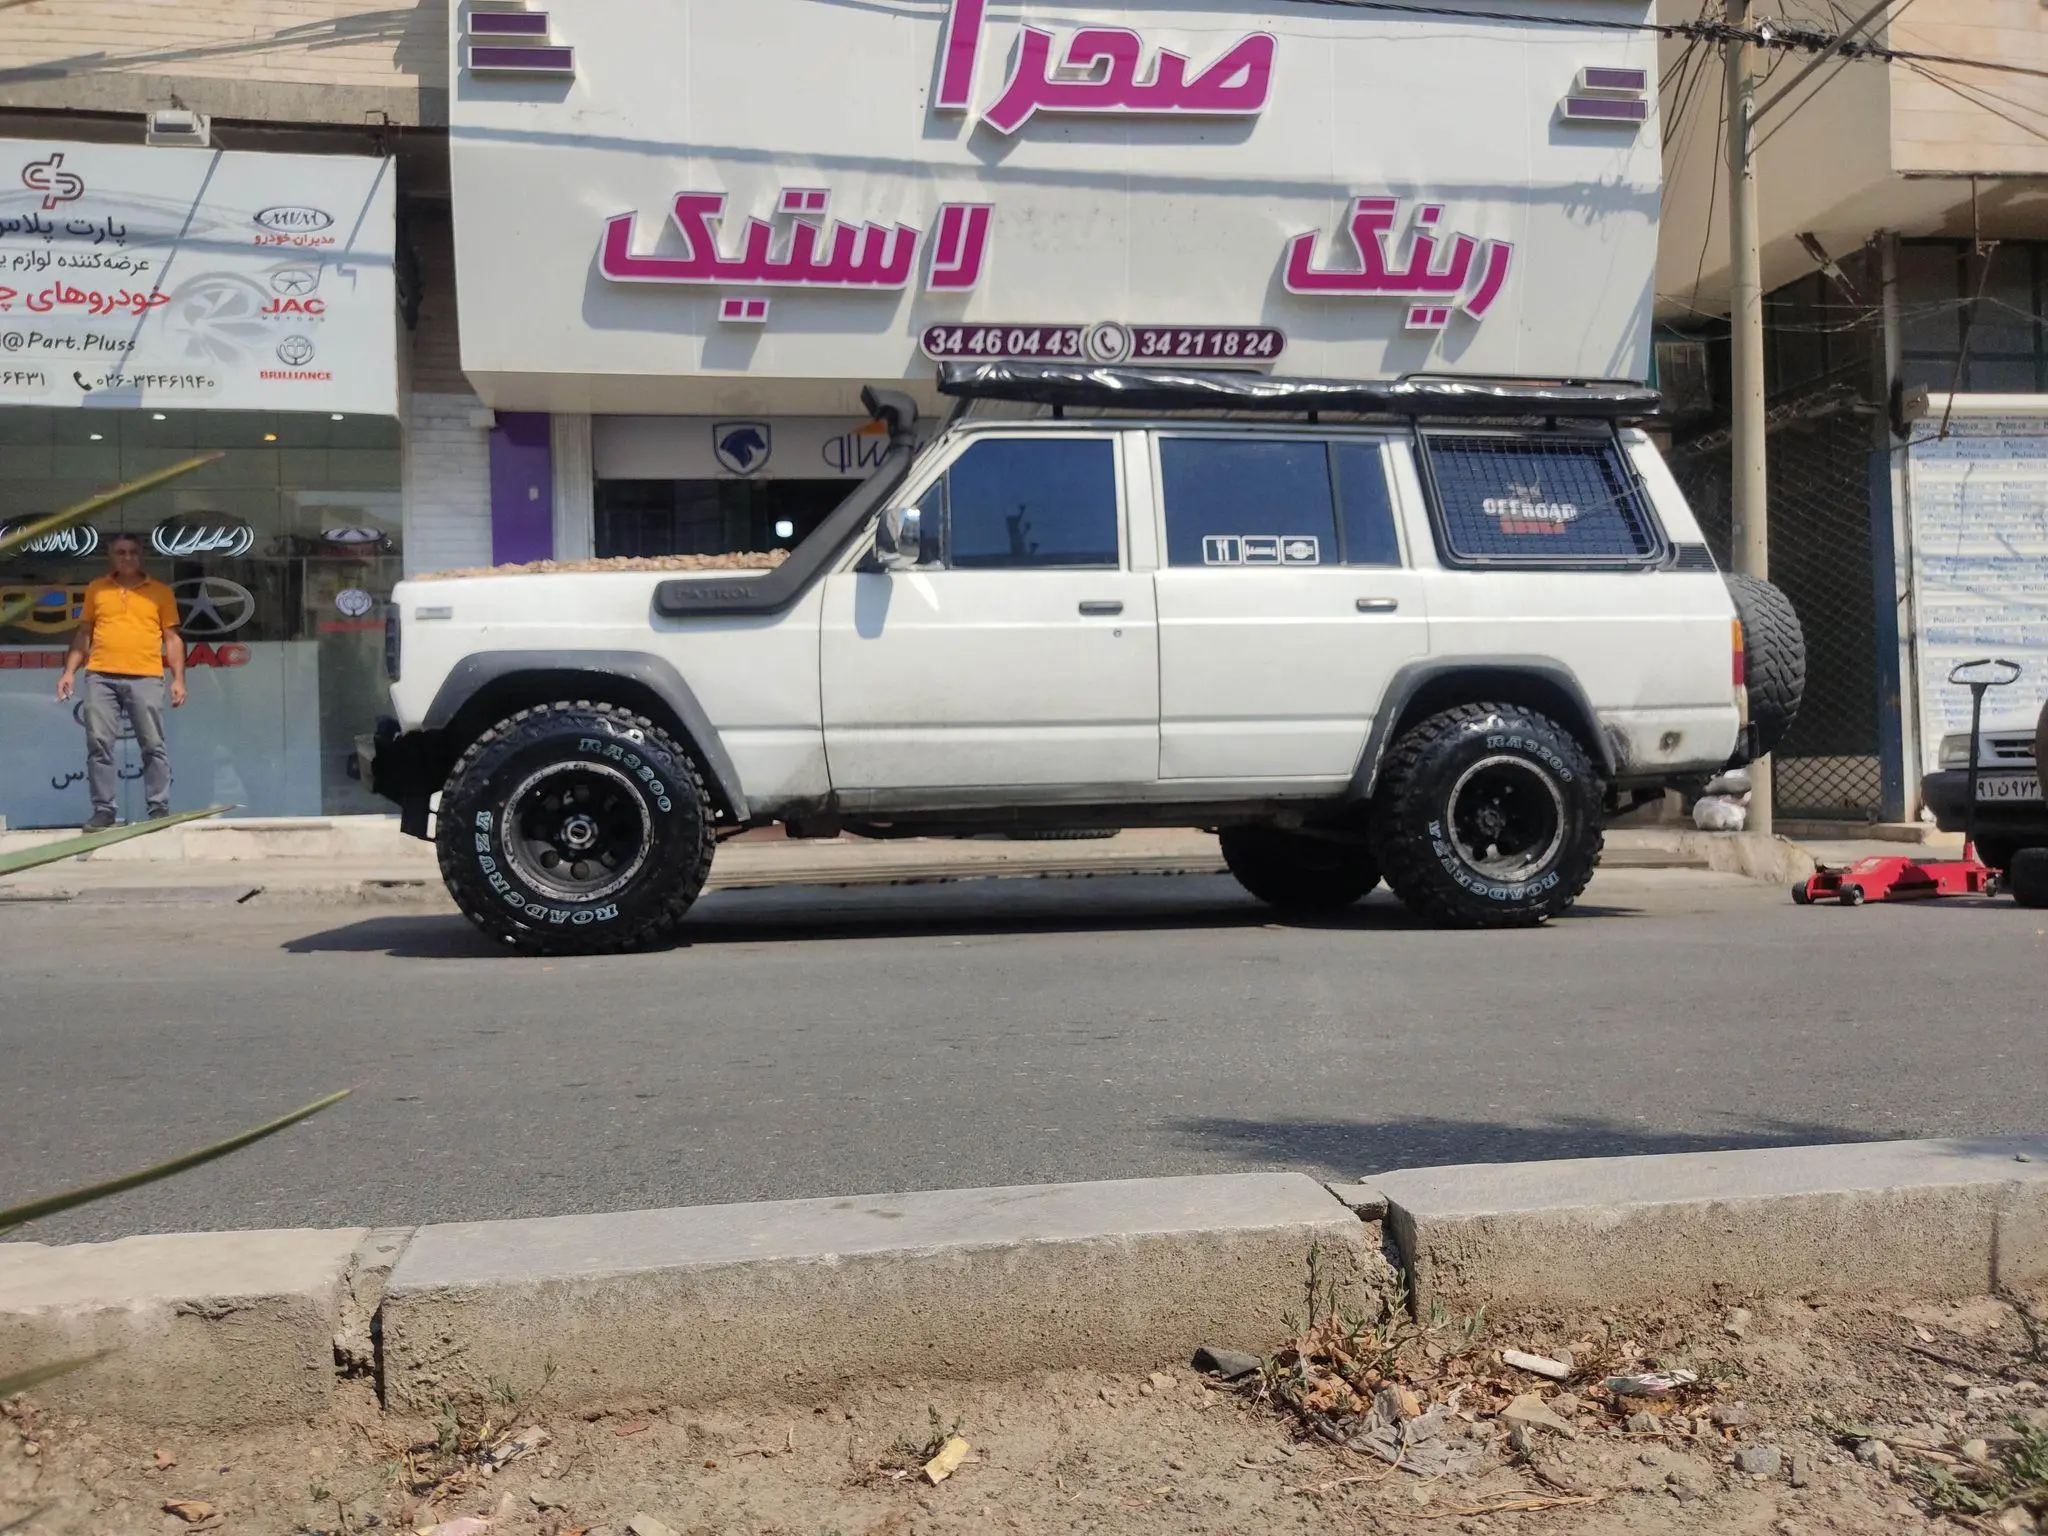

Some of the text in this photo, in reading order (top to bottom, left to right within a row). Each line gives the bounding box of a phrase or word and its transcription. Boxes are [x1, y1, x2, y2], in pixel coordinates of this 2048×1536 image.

[935, 0, 1278, 134] صحرا
[66, 216, 126, 246] پارت
[255, 234, 335, 246] مدیران خودرو
[13, 250, 51, 272] لوازم
[599, 187, 1514, 329] رینگ لاستیک
[26, 281, 171, 315] خودروهای
[261, 299, 325, 314] JAC
[260, 371, 333, 381] BRILLIANCE
